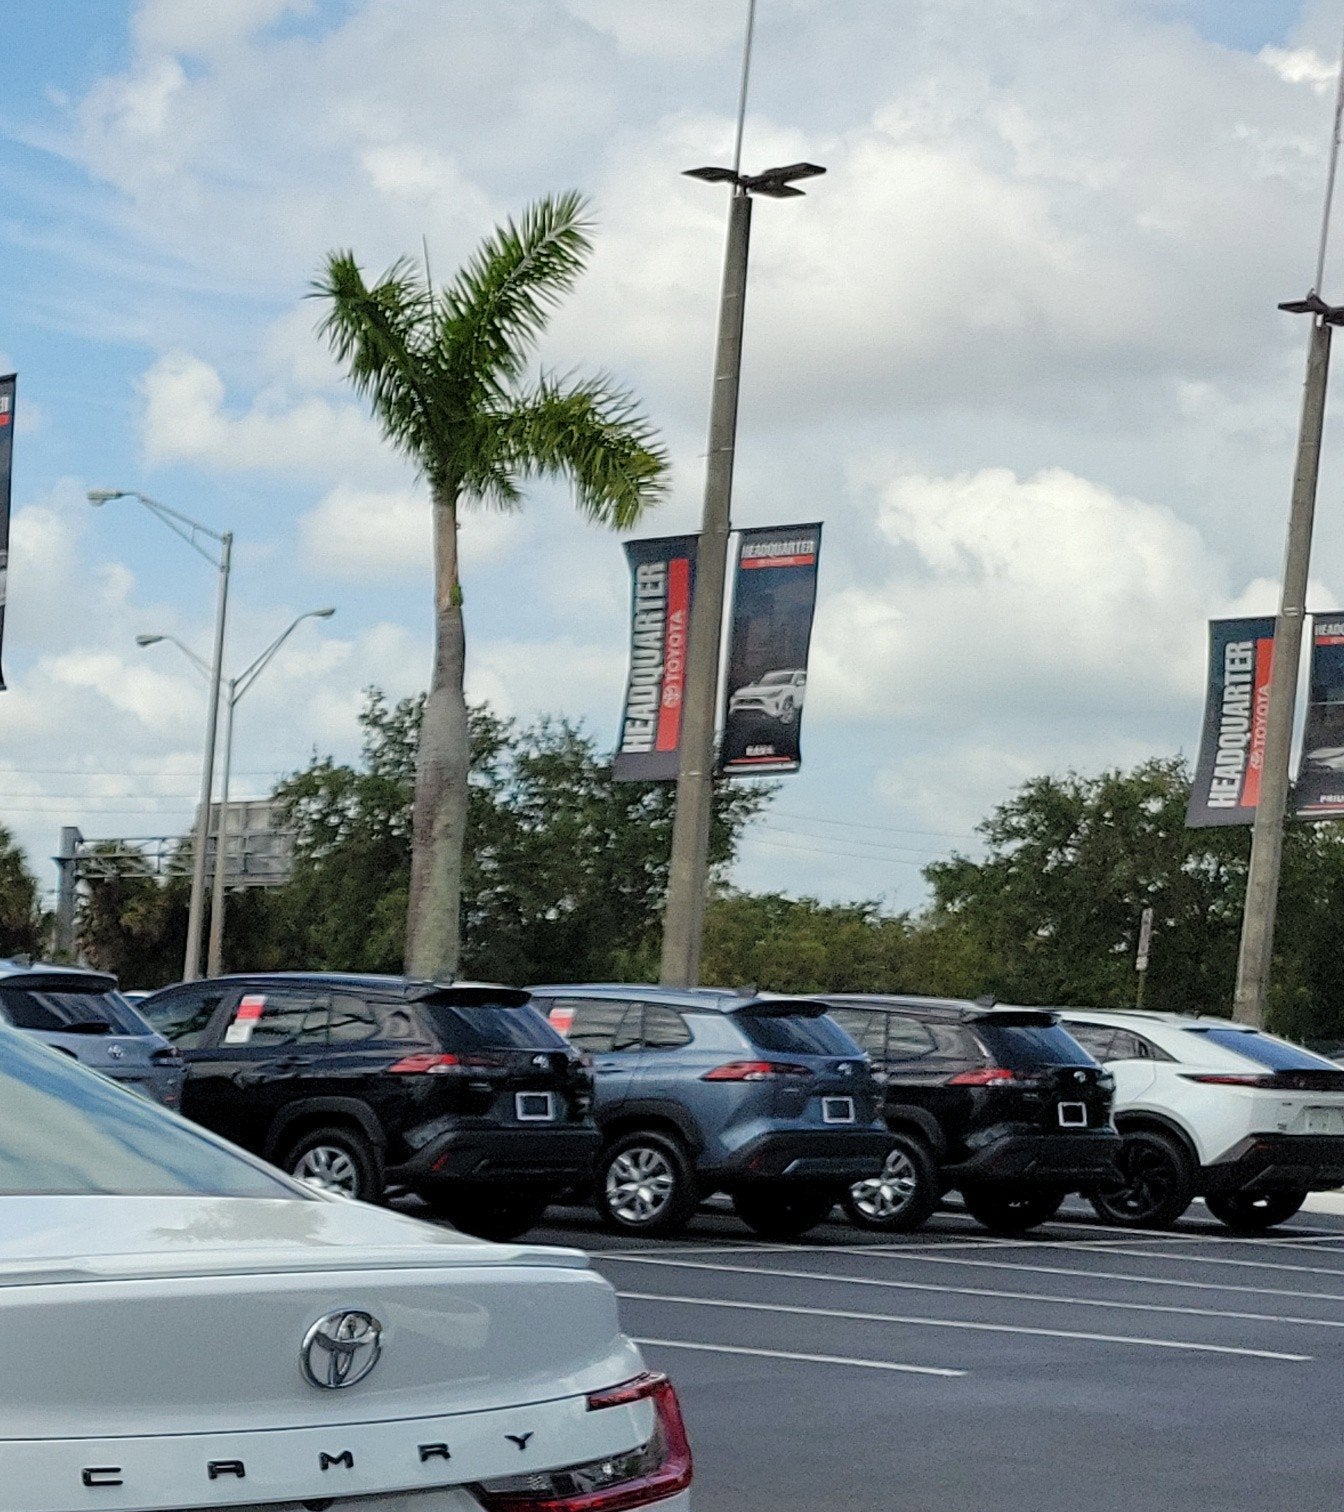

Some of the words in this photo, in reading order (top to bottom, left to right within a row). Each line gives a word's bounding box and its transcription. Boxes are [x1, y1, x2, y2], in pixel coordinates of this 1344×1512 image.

[622, 561, 667, 753] HEADQUARTER
[665, 610, 687, 682] TOYOTA
[1207, 641, 1253, 808] HEADQUARTER
[82, 1431, 534, 1487] CAMRY
